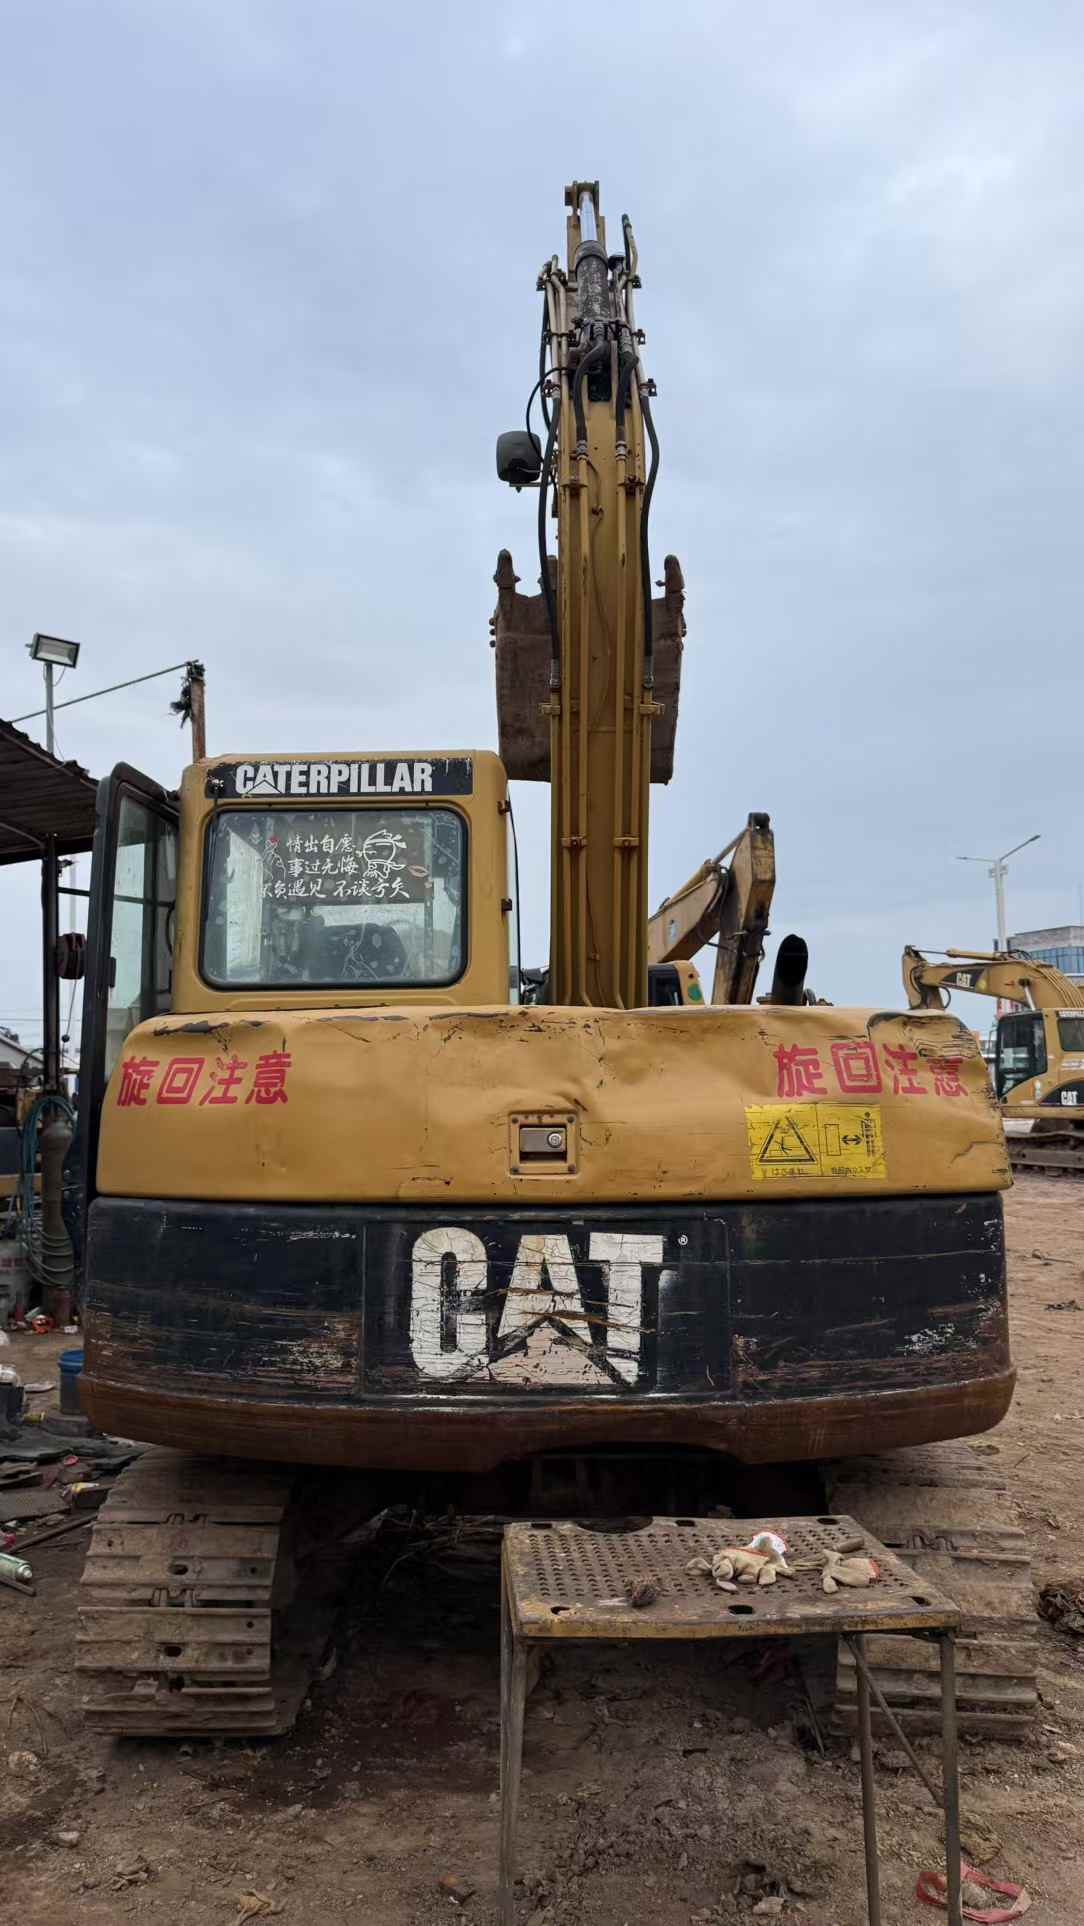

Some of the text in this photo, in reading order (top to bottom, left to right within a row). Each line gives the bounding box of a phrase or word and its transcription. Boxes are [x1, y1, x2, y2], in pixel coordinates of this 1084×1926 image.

[235, 762, 433, 794] CATERPILLAR
[956, 972, 972, 988] CAT
[117, 1050, 291, 1107] 旋回注意
[773, 1040, 968, 1098] 旋回注意
[1061, 1090, 1078, 1105] CAT
[409, 1226, 663, 1387] CAT
